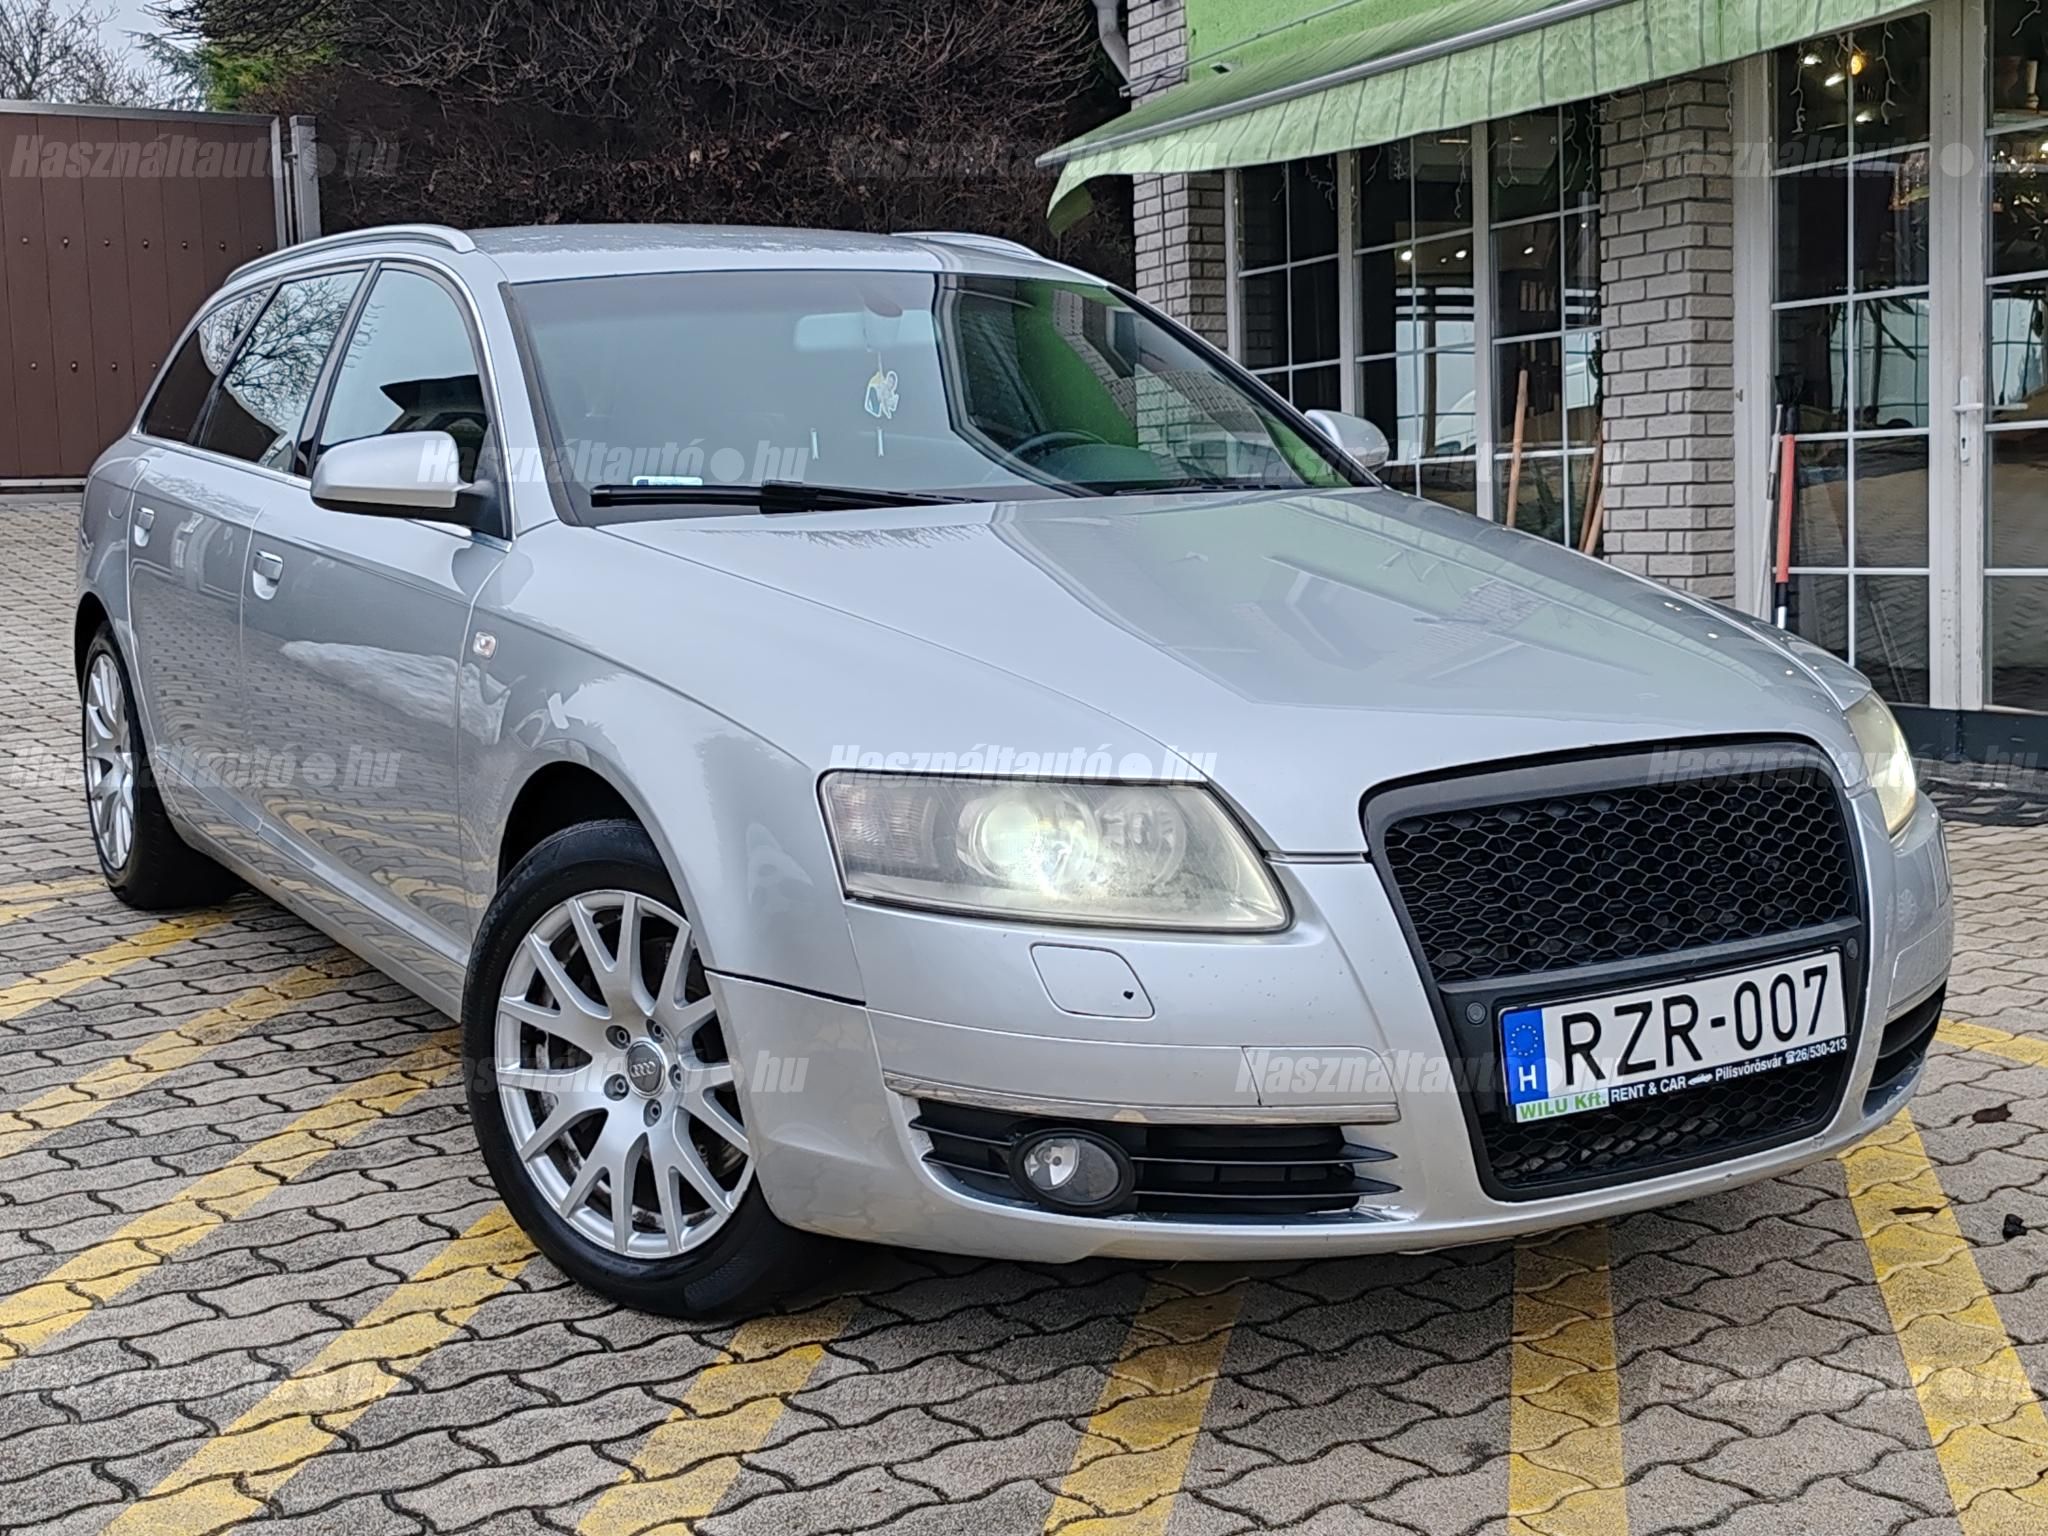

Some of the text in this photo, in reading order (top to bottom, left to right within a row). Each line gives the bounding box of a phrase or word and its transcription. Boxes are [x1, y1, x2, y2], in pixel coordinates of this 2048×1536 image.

[1561, 965, 1828, 1086] RZR-007
[1518, 1064, 1537, 1092] H
[1519, 1098, 1568, 1120] WILU
[1574, 1092, 1607, 1110] Kft.
[1611, 1084, 1645, 1102] RENT
[1647, 1082, 1657, 1096] &
[1660, 1076, 1687, 1093] CAR
[1715, 1054, 1783, 1081] Pilisvörösvár
